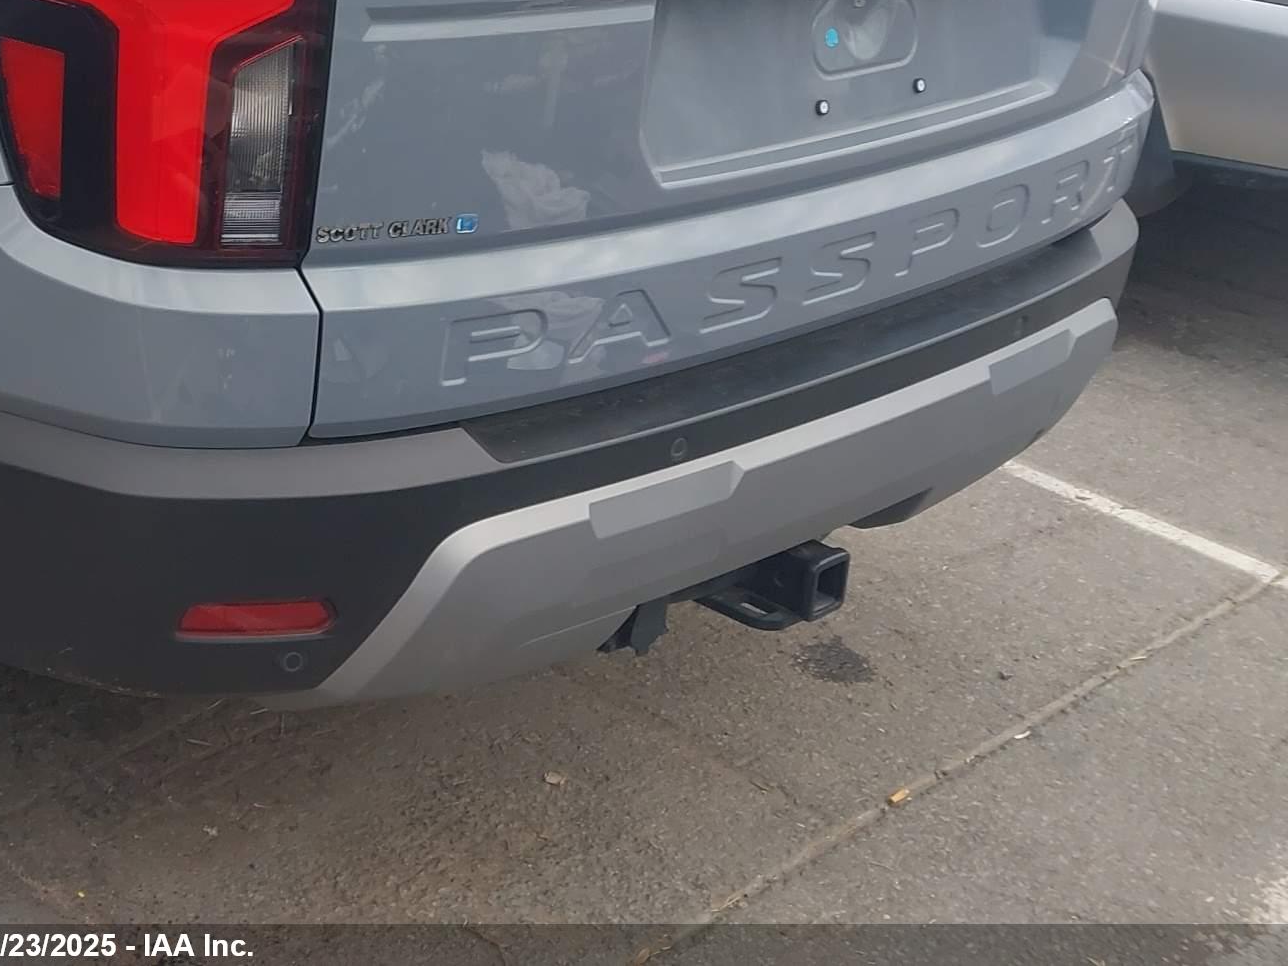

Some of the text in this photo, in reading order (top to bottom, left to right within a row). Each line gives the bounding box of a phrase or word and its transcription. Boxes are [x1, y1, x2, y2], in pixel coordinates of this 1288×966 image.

[316, 216, 452, 244] SCOTT CLARK
[440, 134, 1134, 386] PASSPORT
